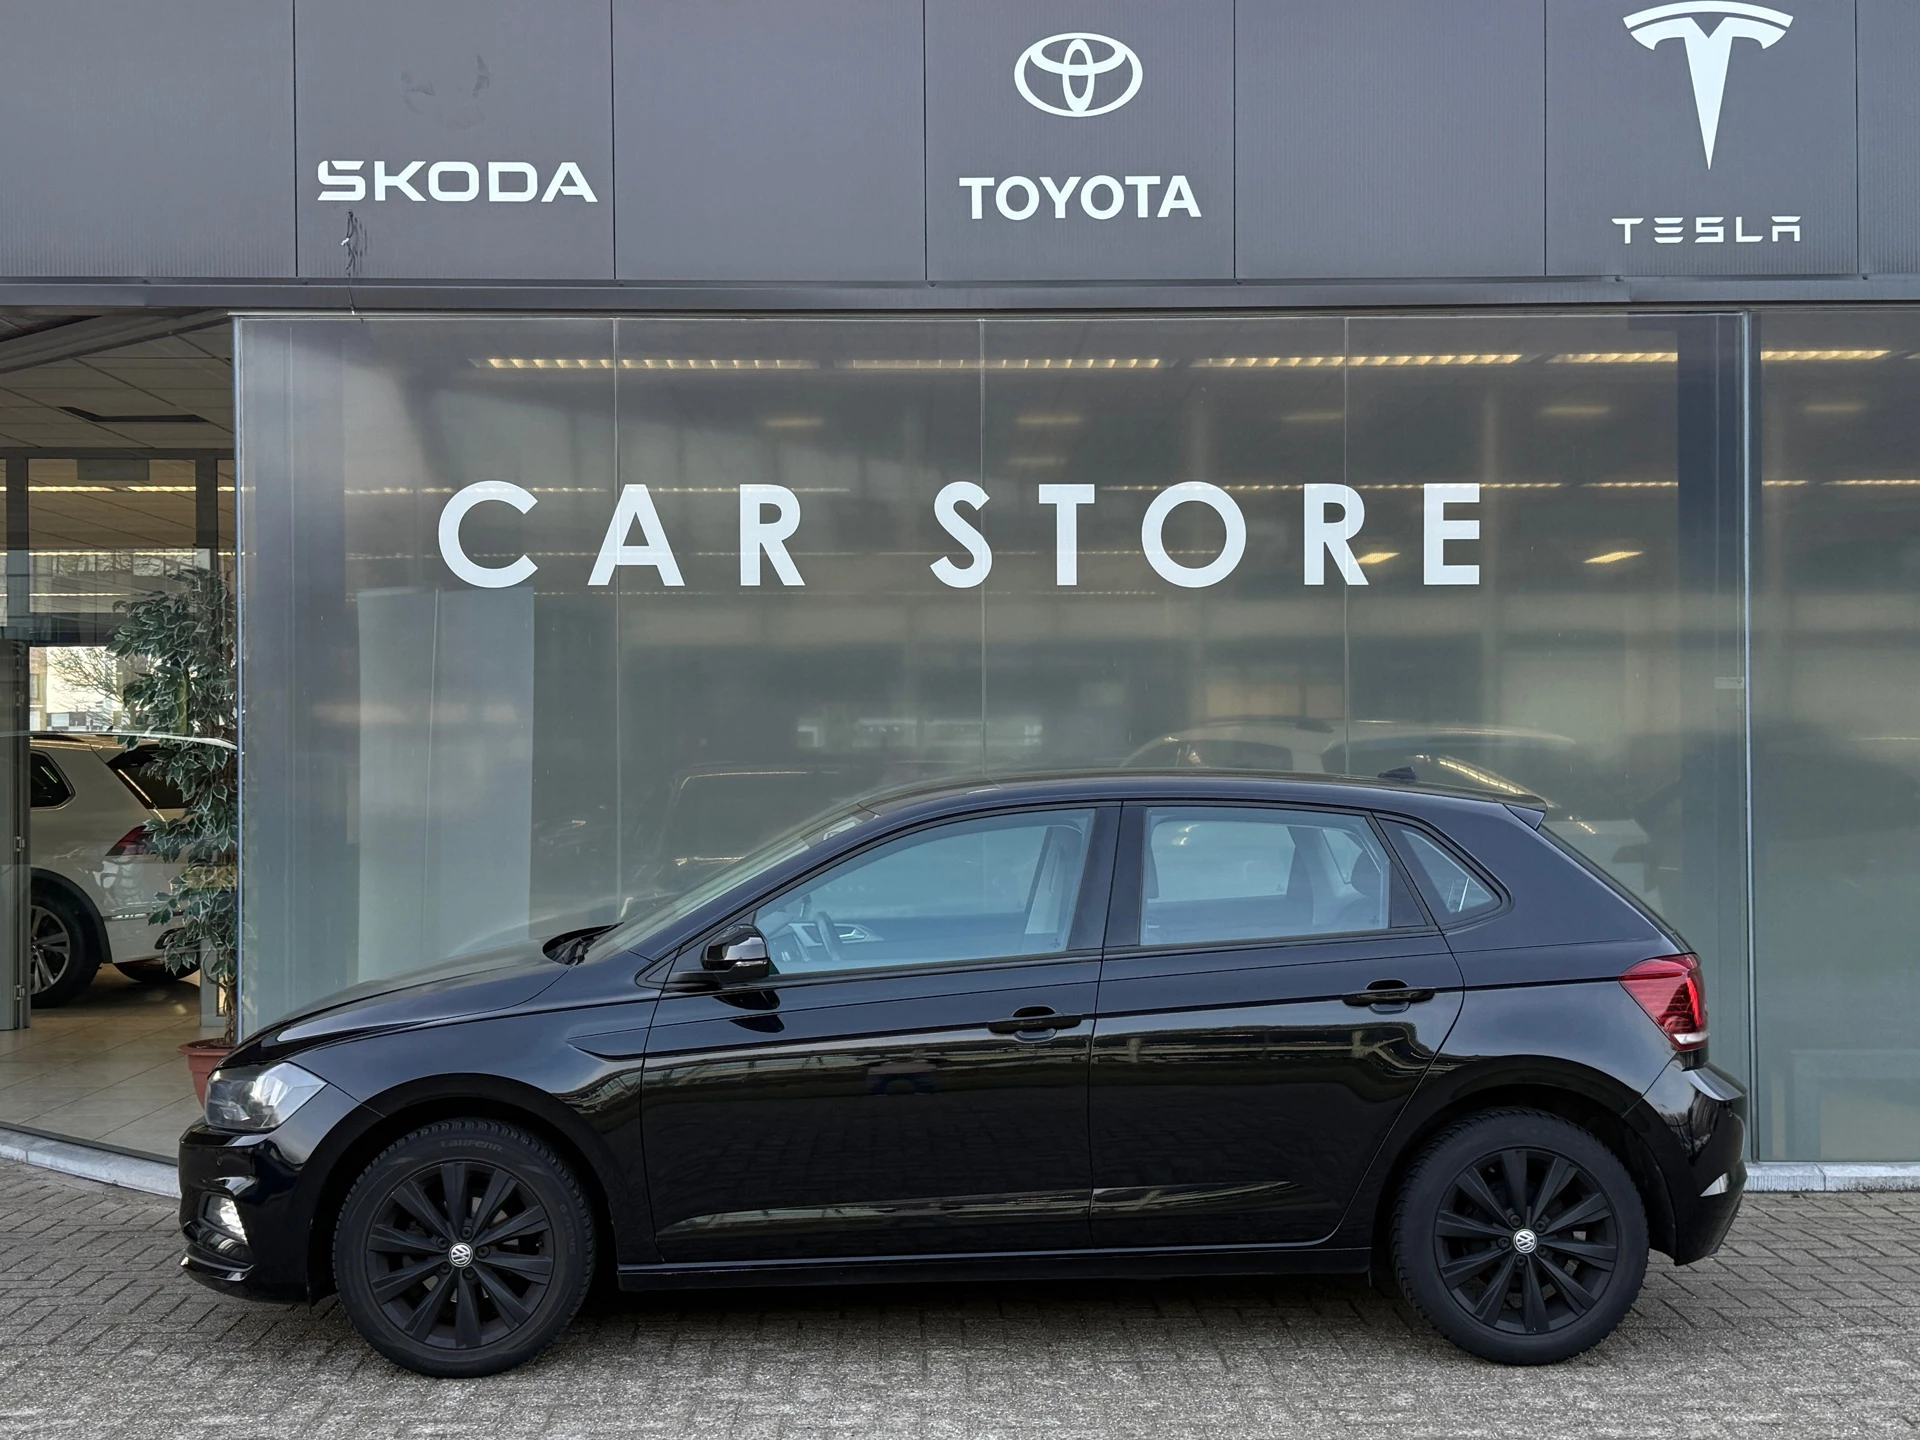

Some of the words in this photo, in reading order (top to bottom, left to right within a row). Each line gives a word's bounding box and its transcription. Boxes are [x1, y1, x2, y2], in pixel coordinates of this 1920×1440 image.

[958, 174, 1202, 221] TOYOTA
[1611, 216, 1801, 244] TESLA
[438, 481, 806, 588] CAR
[930, 481, 1486, 588] STORE
